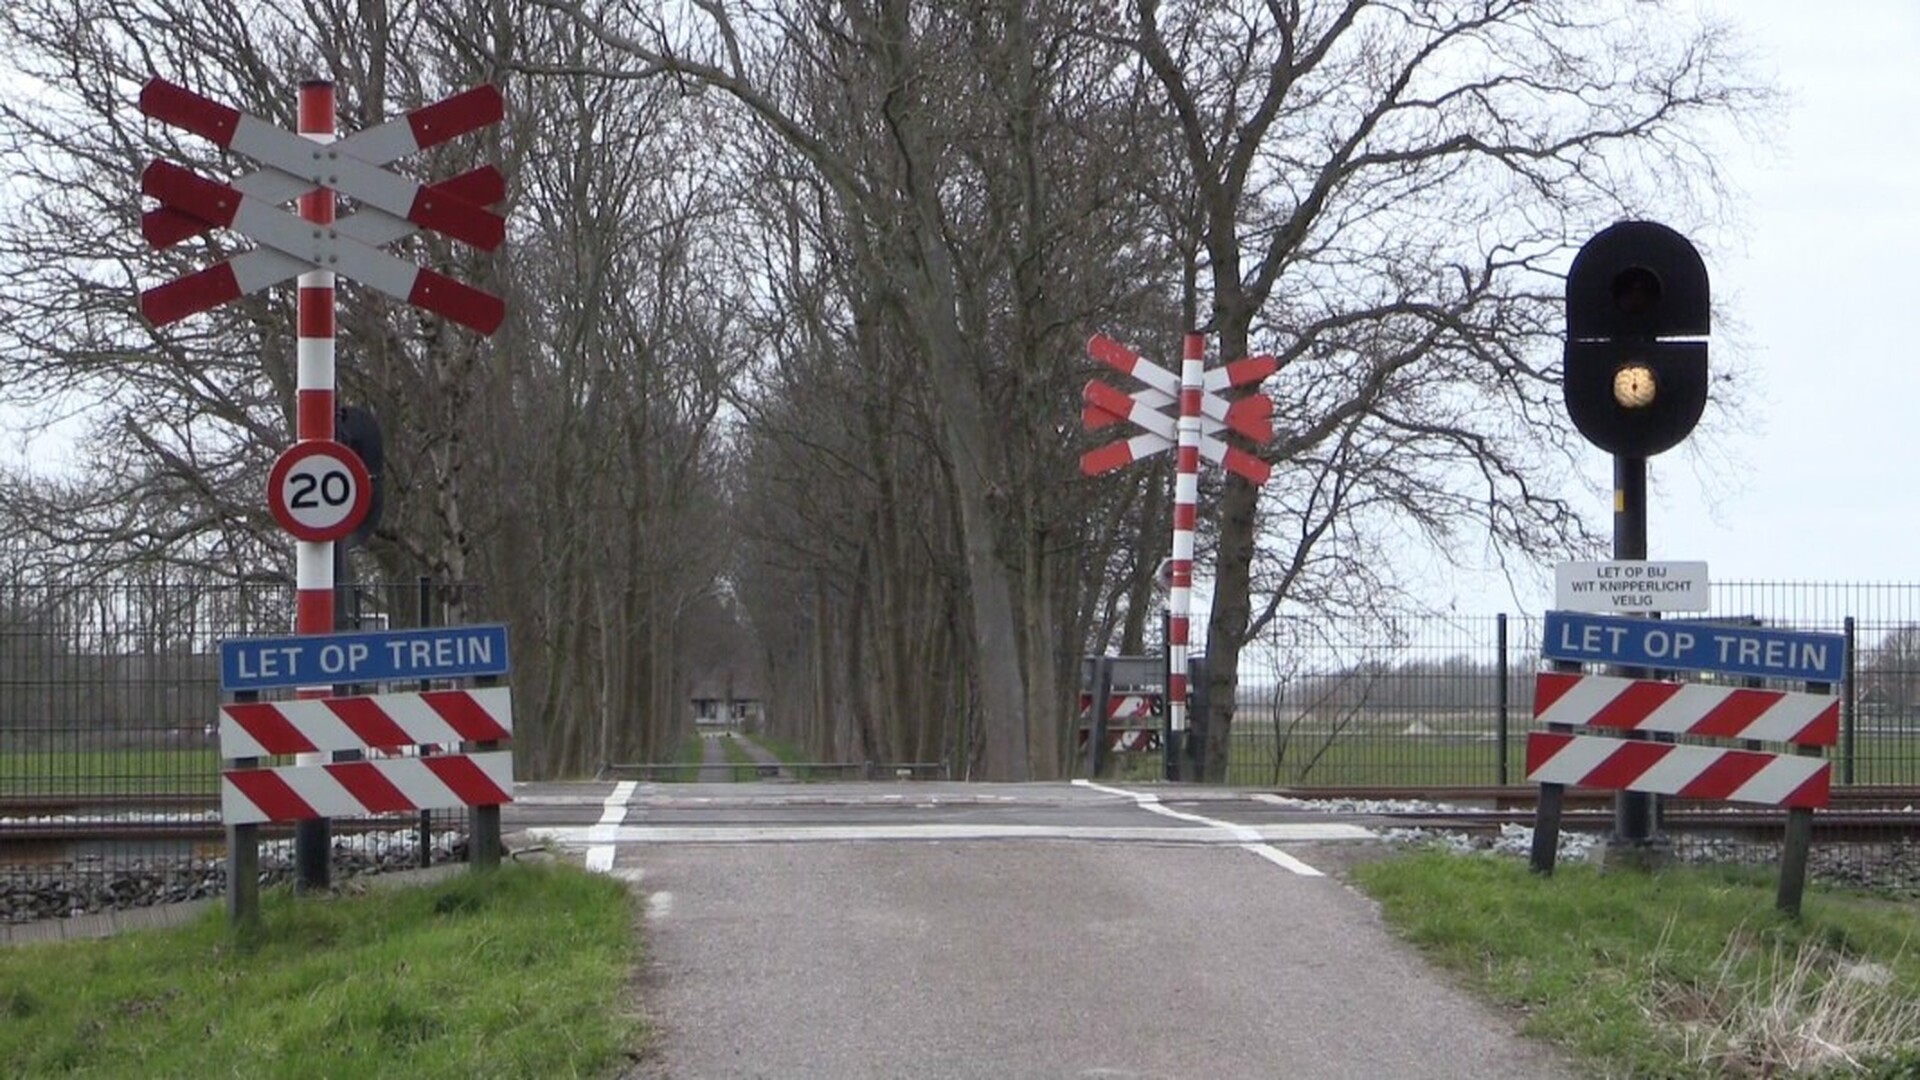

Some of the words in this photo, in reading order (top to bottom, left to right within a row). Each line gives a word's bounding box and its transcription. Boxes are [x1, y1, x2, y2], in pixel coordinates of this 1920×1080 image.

[290, 470, 350, 509] 20
[1597, 566, 1619, 578] LET
[1625, 566, 1643, 578] OP
[1647, 567, 1667, 578] BIJ
[1572, 581, 1595, 592] WIT
[1599, 580, 1692, 592] KNIPPERLICHT
[1612, 595, 1653, 606] VEILIG
[238, 647, 303, 679] LET
[319, 644, 369, 673] OP
[386, 636, 492, 669] TREIN
[1561, 622, 1628, 654] LET
[1643, 630, 1696, 659] OP
[1714, 635, 1827, 671] TREIN
